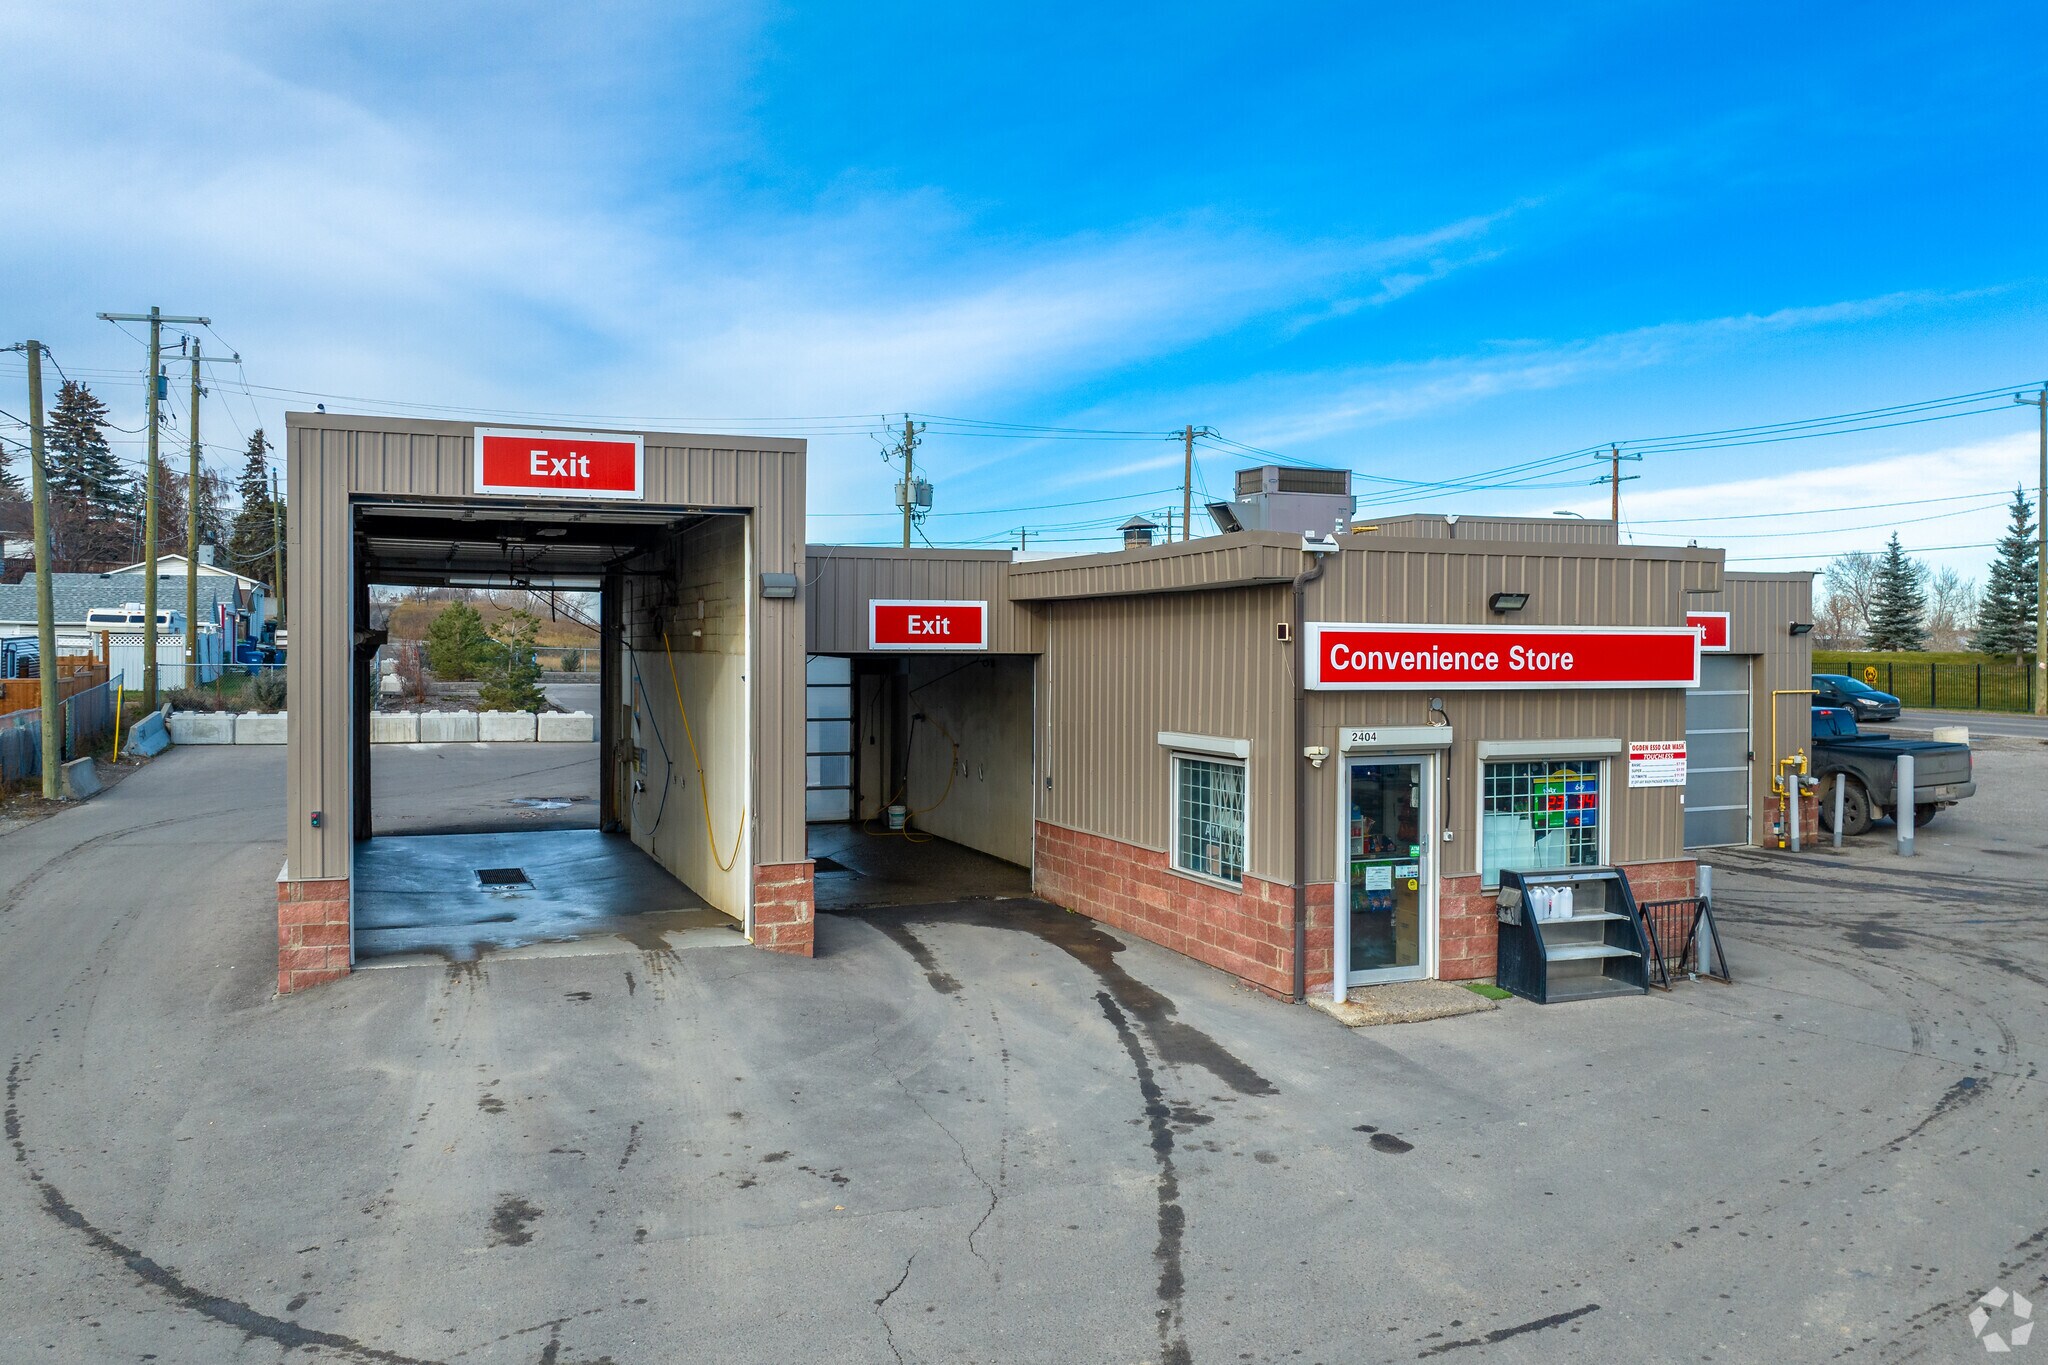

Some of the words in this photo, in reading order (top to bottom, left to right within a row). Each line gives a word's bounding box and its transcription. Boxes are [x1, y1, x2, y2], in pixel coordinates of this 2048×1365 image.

[530, 450, 590, 478] Exit
[908, 614, 950, 635] Exit
[1330, 643, 1499, 671] Convenience
[1509, 645, 1574, 671] Store
[1352, 732, 1377, 742] 2404
[1644, 752, 1674, 760] TOUCHLESS
[1205, 823, 1221, 838] ATM
